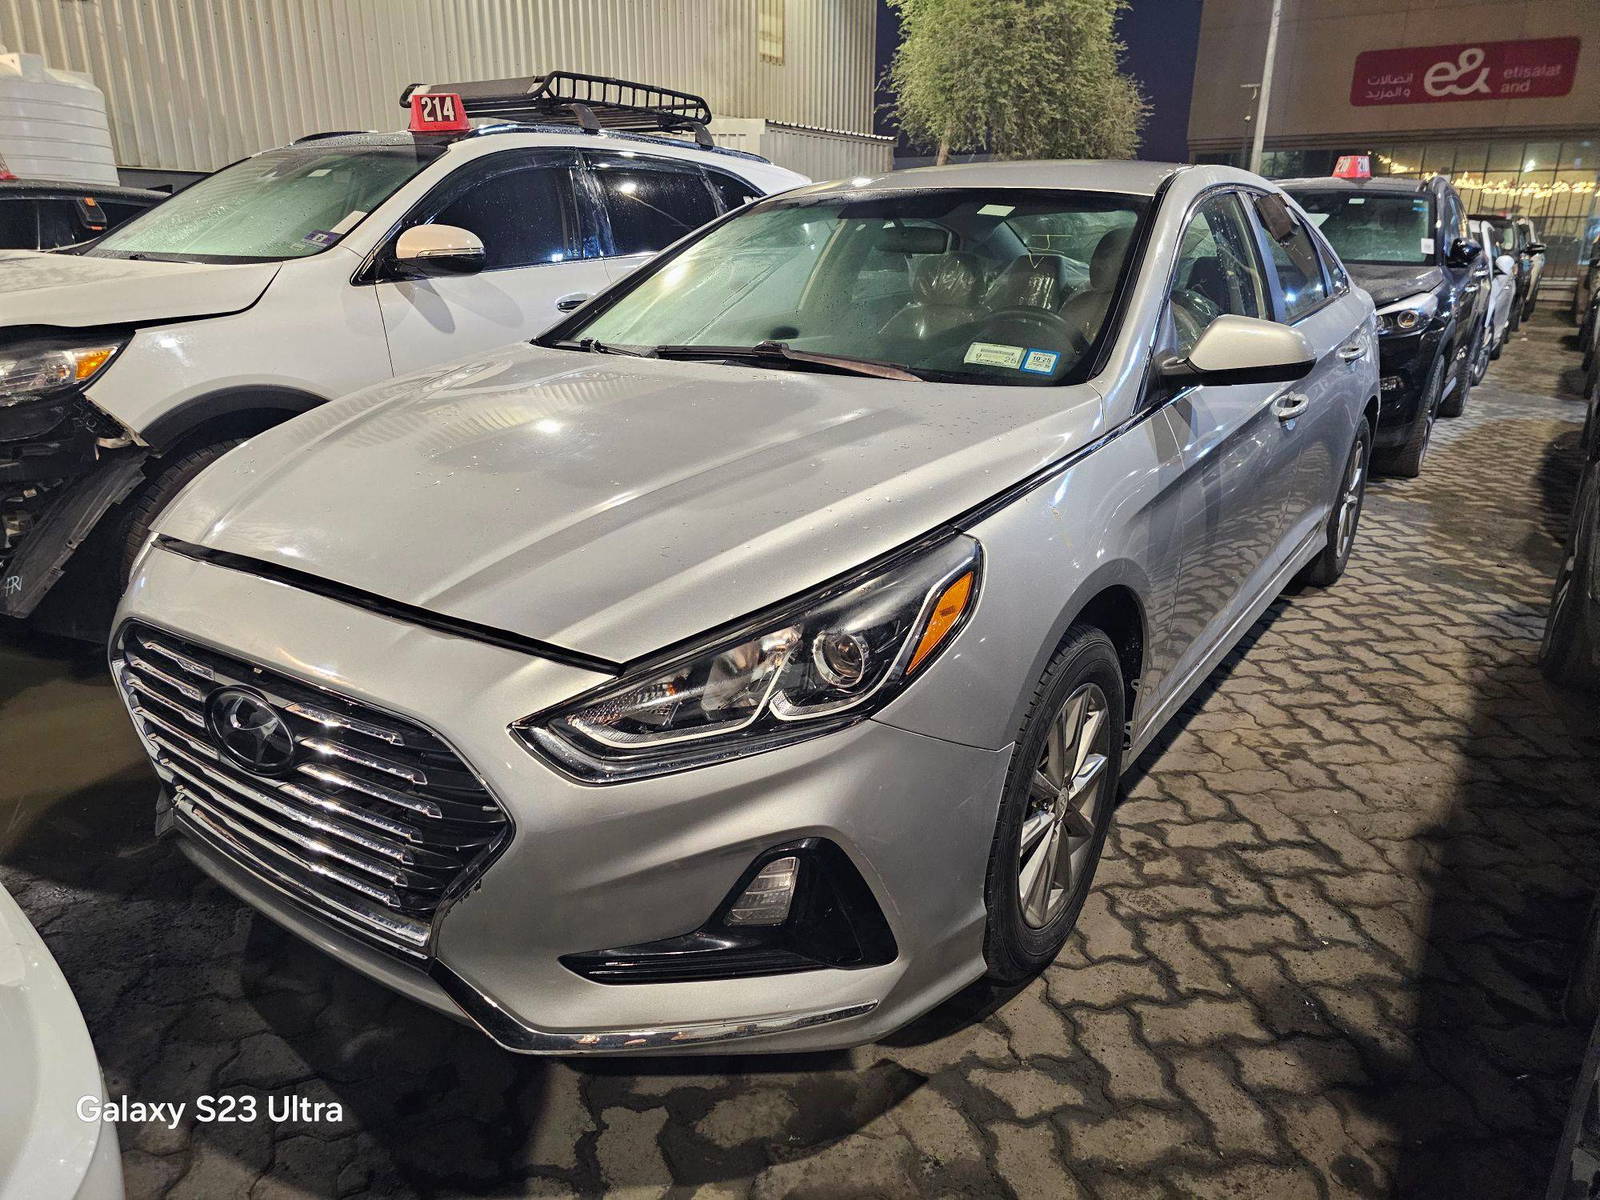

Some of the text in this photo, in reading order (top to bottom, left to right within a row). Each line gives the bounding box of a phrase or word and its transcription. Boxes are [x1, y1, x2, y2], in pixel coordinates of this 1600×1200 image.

[1423, 47, 1492, 97] e&
[1503, 64, 1562, 80] etisalat
[1366, 73, 1414, 86] اتصالات
[1365, 88, 1411, 100] والمزيد
[1500, 81, 1531, 94] and
[421, 96, 455, 122] 214
